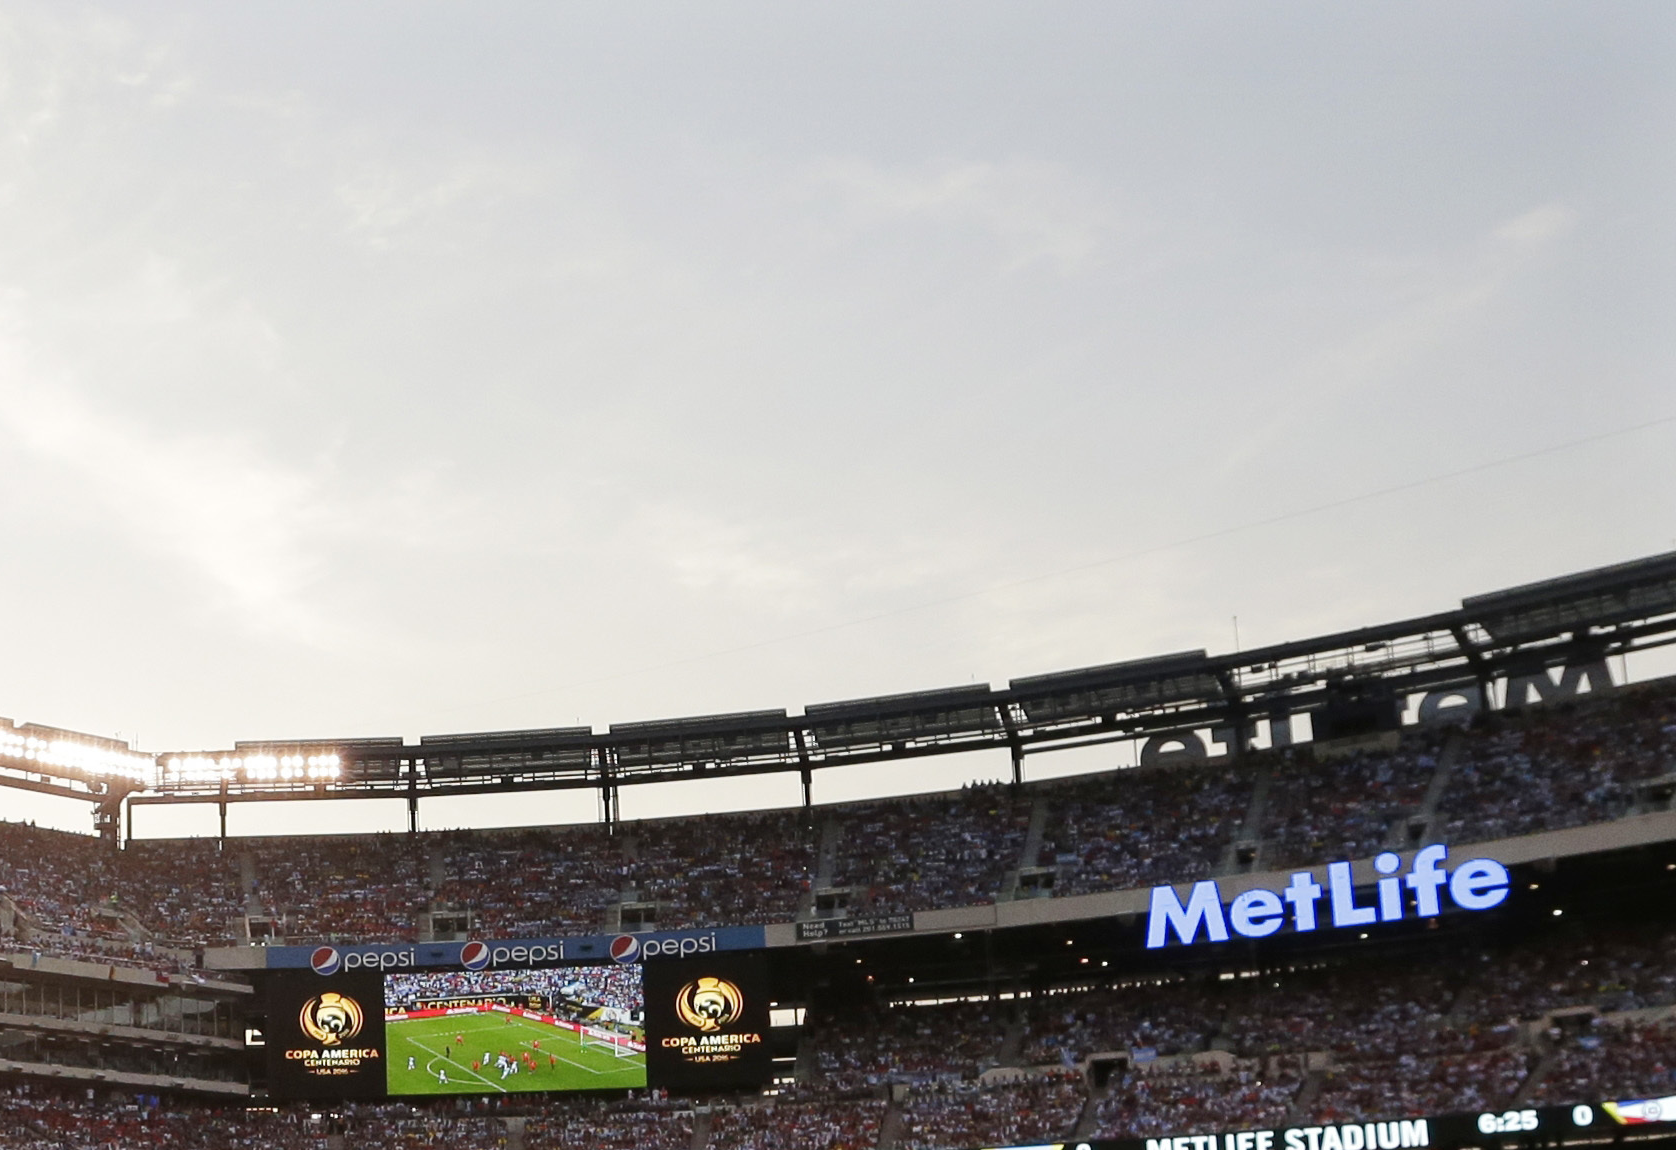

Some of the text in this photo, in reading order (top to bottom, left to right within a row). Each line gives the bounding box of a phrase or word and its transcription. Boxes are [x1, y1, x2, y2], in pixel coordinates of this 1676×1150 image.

[1146, 844, 1511, 949] MetLife
[802, 922, 825, 930] Need
[802, 930, 828, 938] Help?
[492, 940, 564, 966] pepsi
[643, 932, 716, 960] pepsi
[345, 948, 415, 971] pepsi
[662, 1034, 761, 1048] COPA AMERICA
[285, 1048, 379, 1060] COPA AMERICA
[681, 1044, 742, 1054] CENTENARIO
[304, 1059, 360, 1067] CENTENARIO
[1477, 1104, 1594, 1135] 6:25 0
